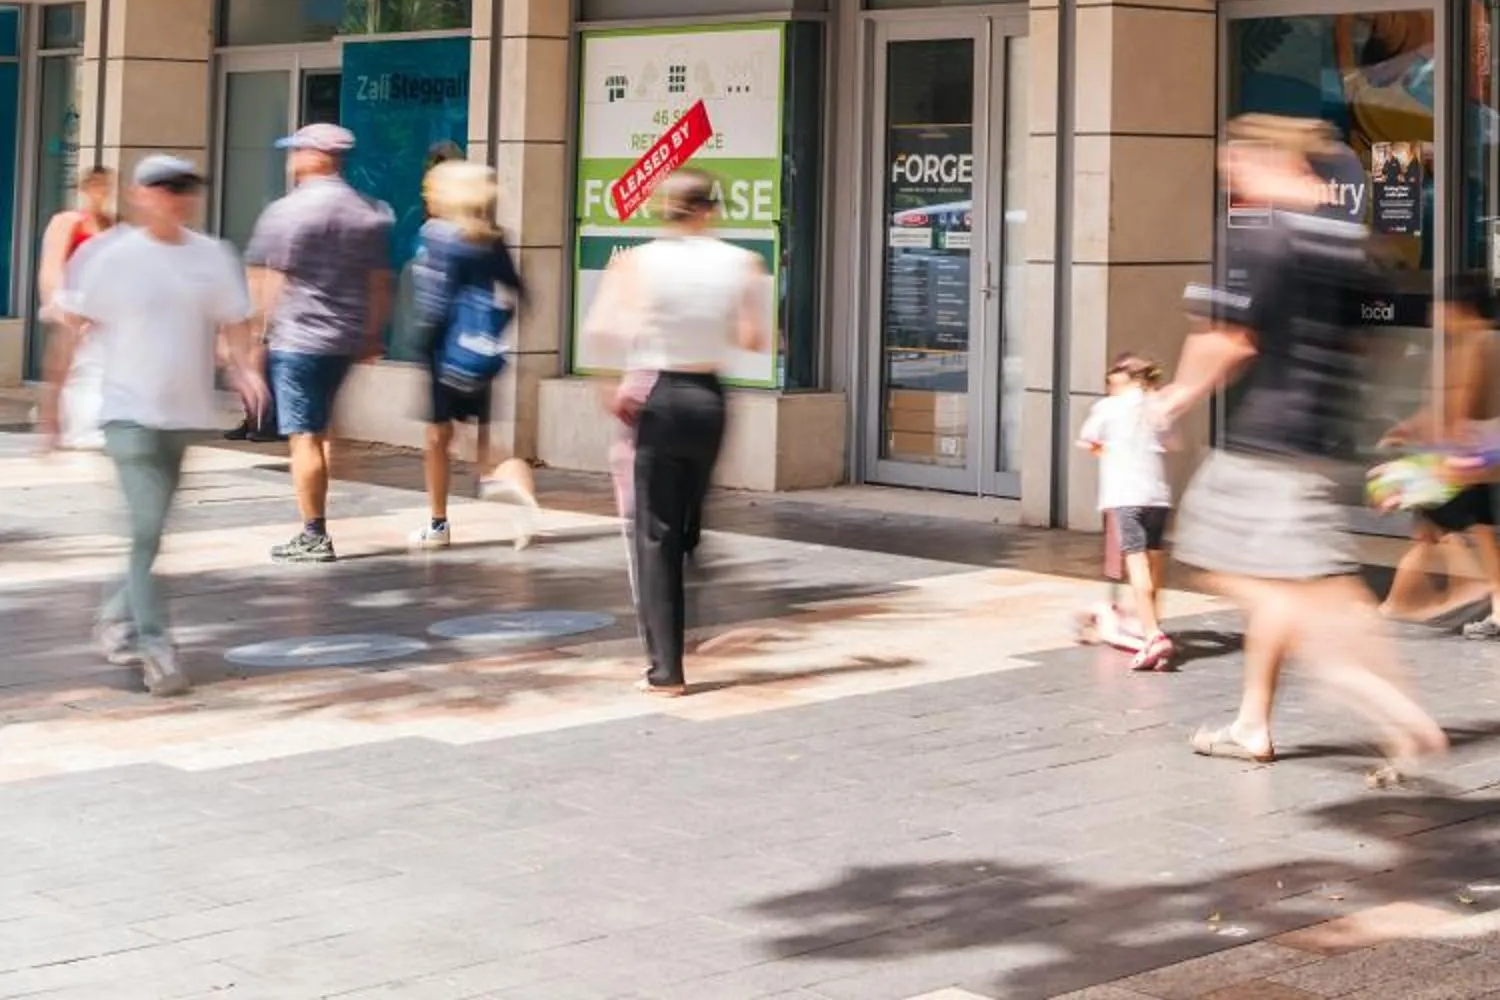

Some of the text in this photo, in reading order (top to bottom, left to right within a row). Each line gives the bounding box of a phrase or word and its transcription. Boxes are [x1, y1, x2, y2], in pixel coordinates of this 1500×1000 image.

[618, 143, 671, 201] LEASED
[670, 119, 690, 149] BY
[891, 151, 973, 183] FORGE
[1313, 177, 1365, 216] ntry
[1360, 303, 1395, 321] local
